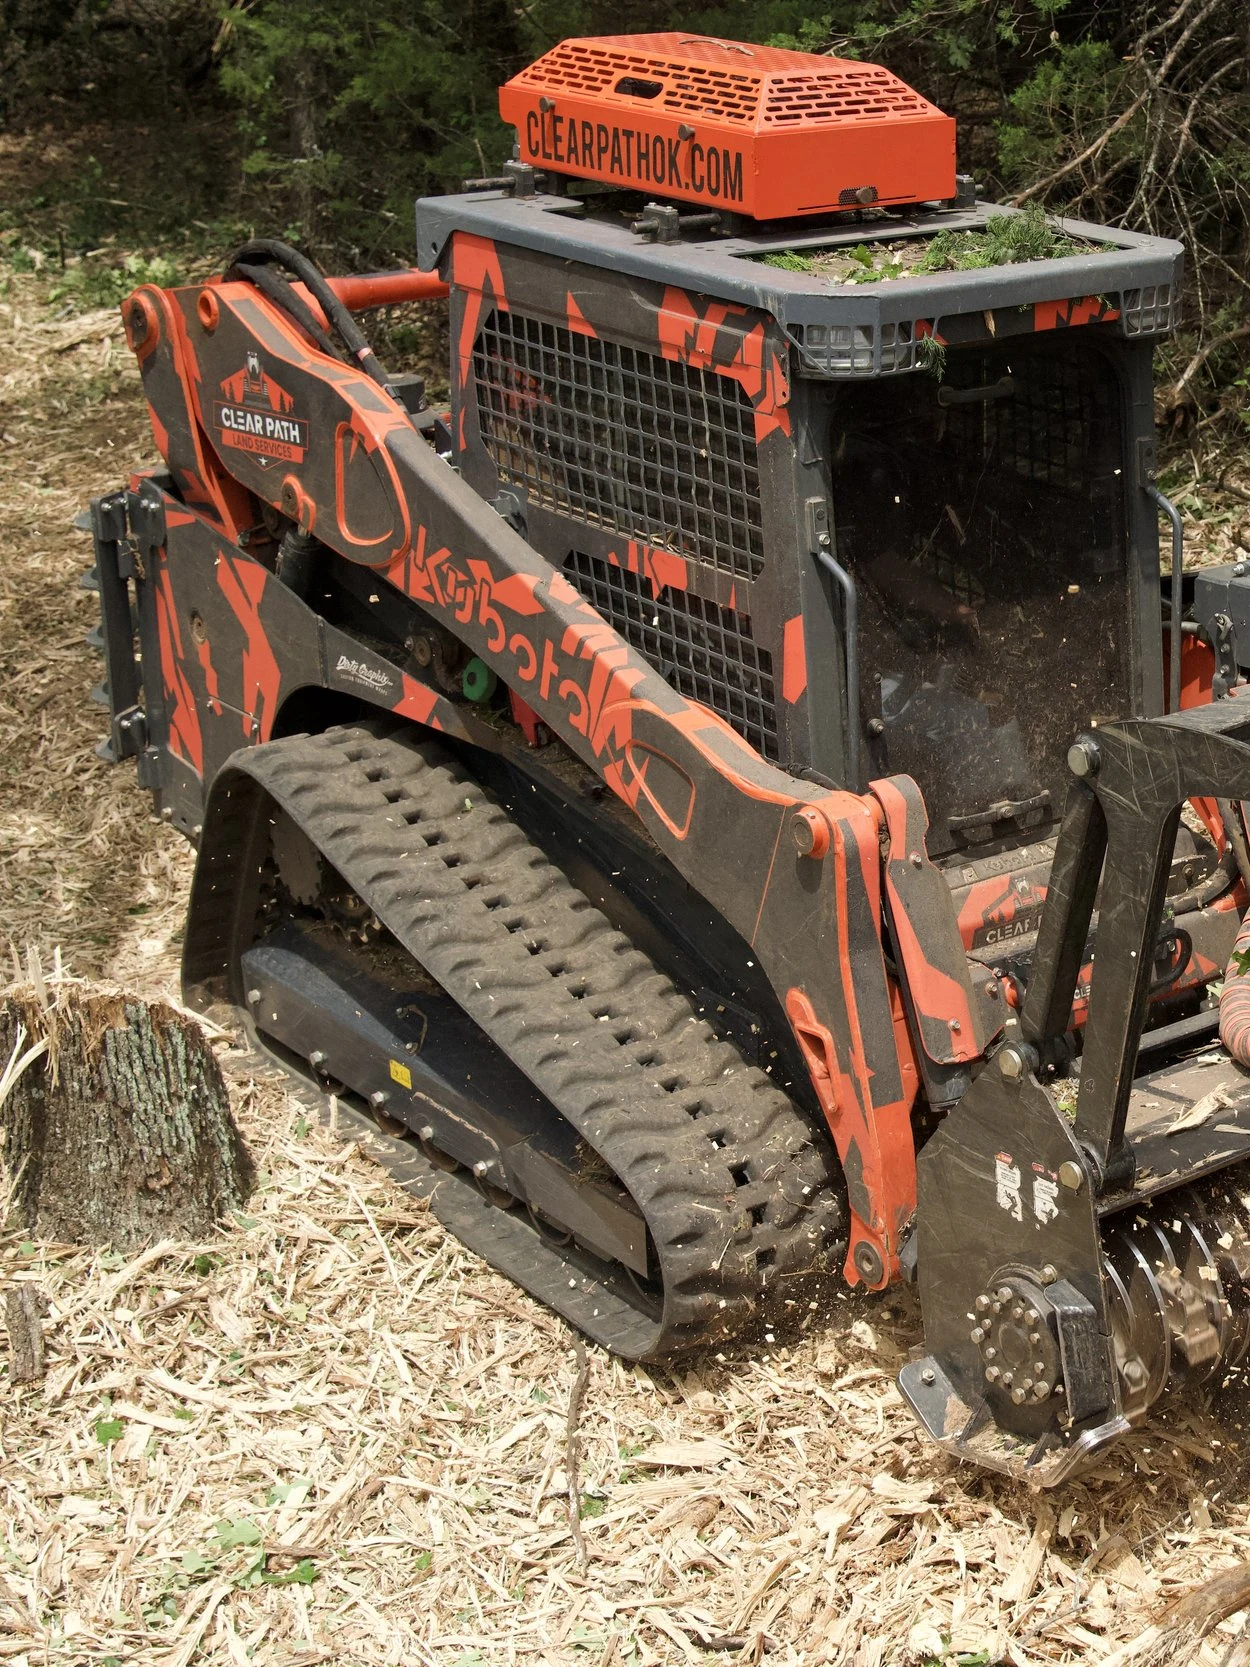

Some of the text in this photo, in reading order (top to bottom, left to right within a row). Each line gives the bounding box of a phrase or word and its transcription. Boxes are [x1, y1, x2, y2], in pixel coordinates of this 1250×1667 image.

[526, 110, 743, 202] CLEARPATHOK.COM
[221, 408, 300, 443] CLEAR PATH
[233, 434, 292, 459] LAND SERVICES
[336, 656, 358, 676] Dirty
